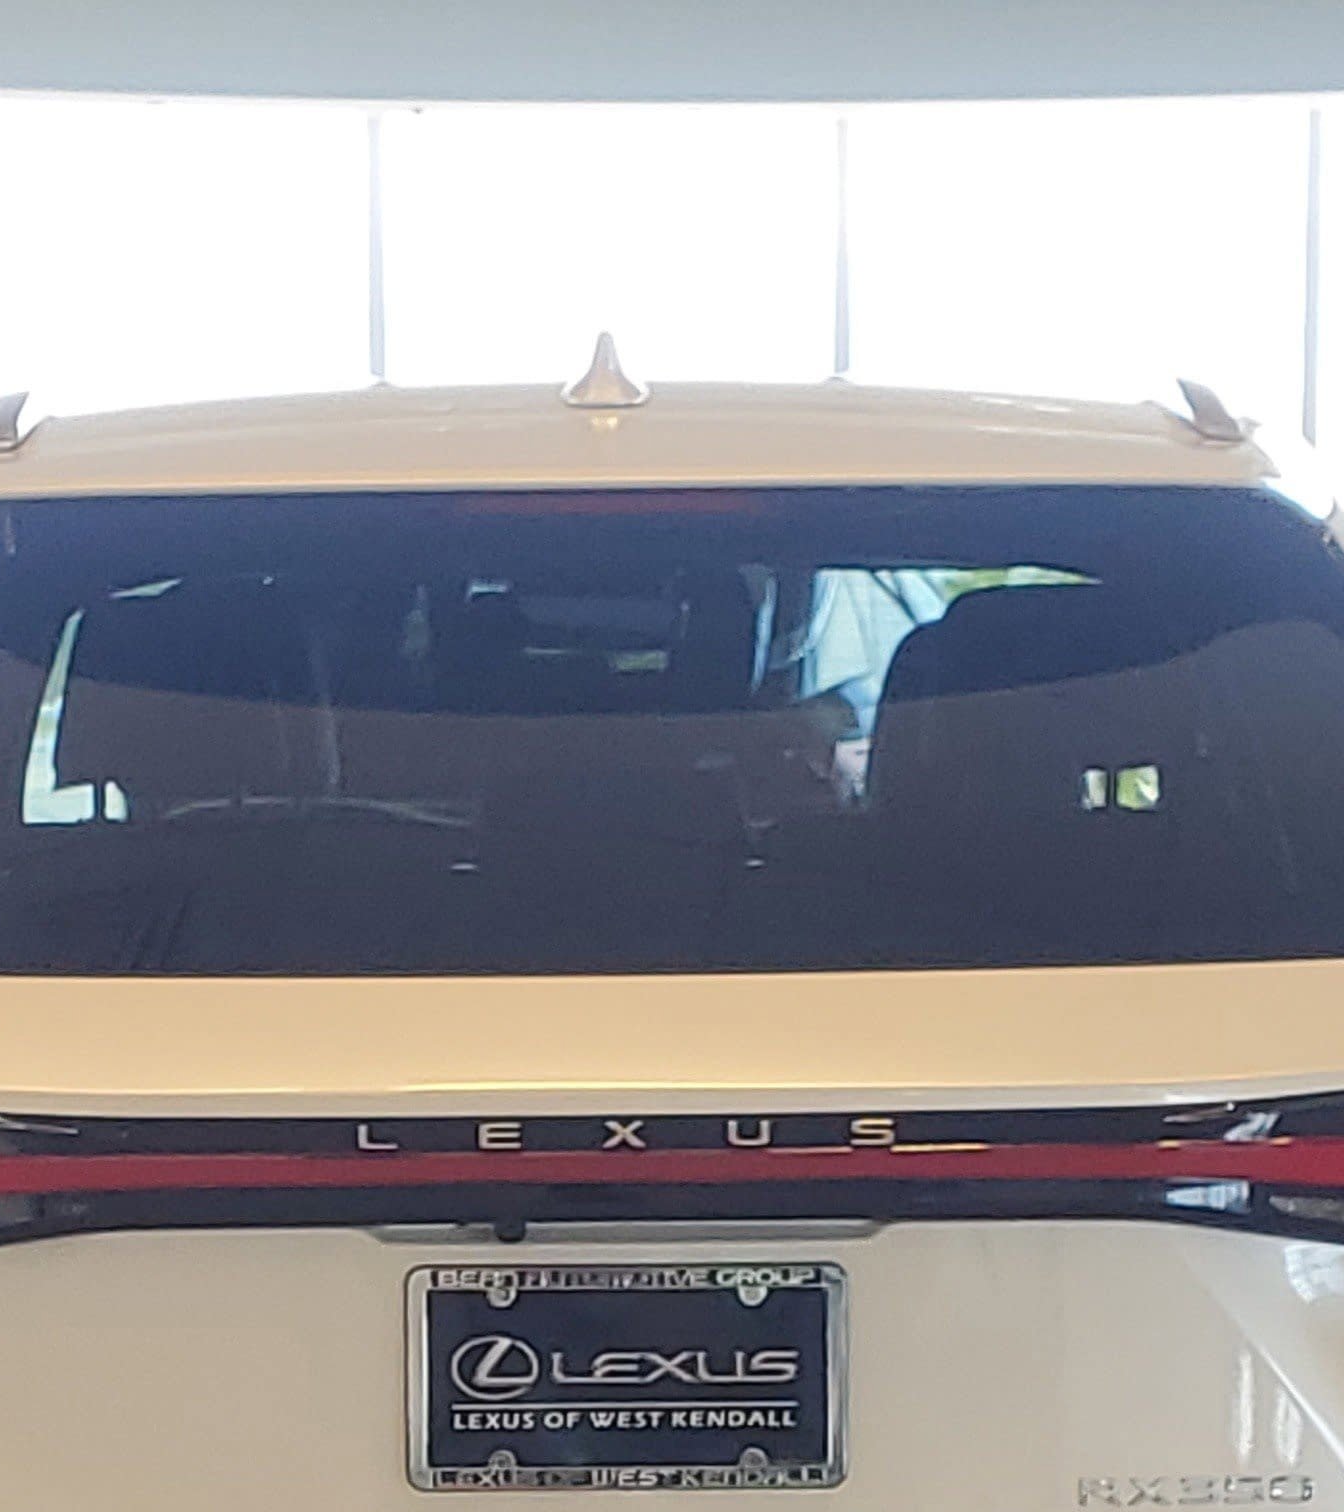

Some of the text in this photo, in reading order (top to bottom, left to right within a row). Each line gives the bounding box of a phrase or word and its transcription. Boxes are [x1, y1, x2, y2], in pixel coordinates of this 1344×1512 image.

[356, 1117, 896, 1151] LEXUS
[714, 1268, 817, 1287] GROUP
[551, 1350, 799, 1384] LEXUS
[454, 1409, 798, 1431] LEXUS OF WEST KENDALL
